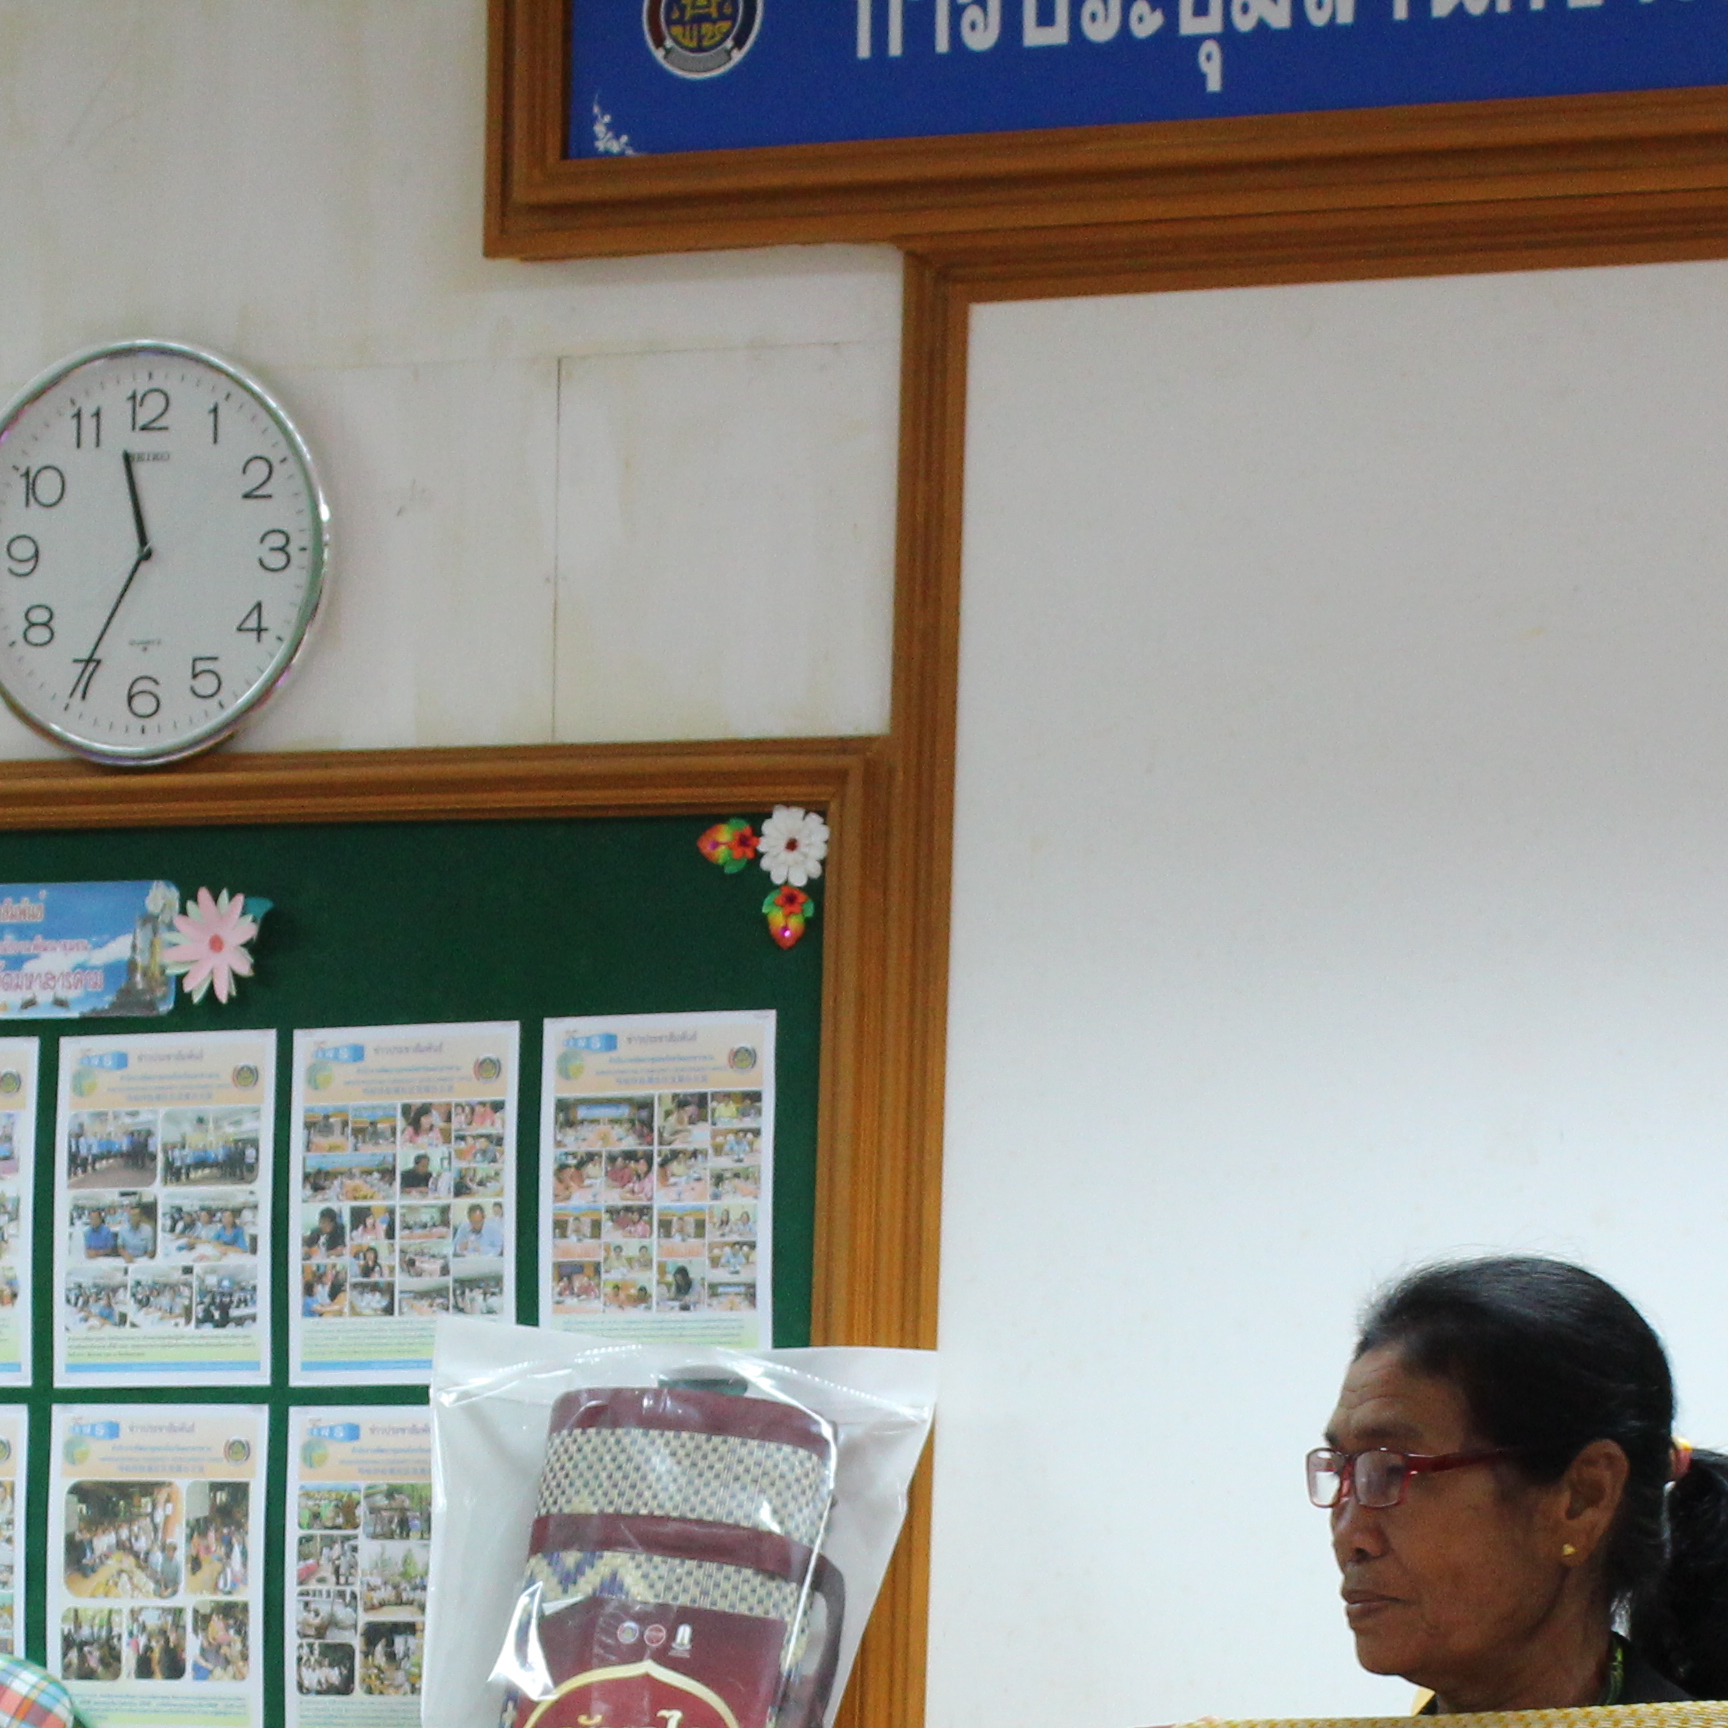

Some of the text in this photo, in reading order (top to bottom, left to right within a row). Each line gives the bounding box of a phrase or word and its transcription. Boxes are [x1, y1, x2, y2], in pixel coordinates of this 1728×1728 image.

[71, 406, 102, 448] 11
[126, 388, 170, 432] 12
[208, 402, 220, 444] 1
[20, 465, 66, 508] 10
[242, 456, 274, 499] 2
[6, 535, 39, 578] 9
[258, 530, 292, 572] 3
[23, 604, 55, 647] 8
[236, 600, 268, 643] 4
[72, 658, 102, 700] 7
[127, 676, 161, 718] 6
[191, 656, 222, 699] 5
